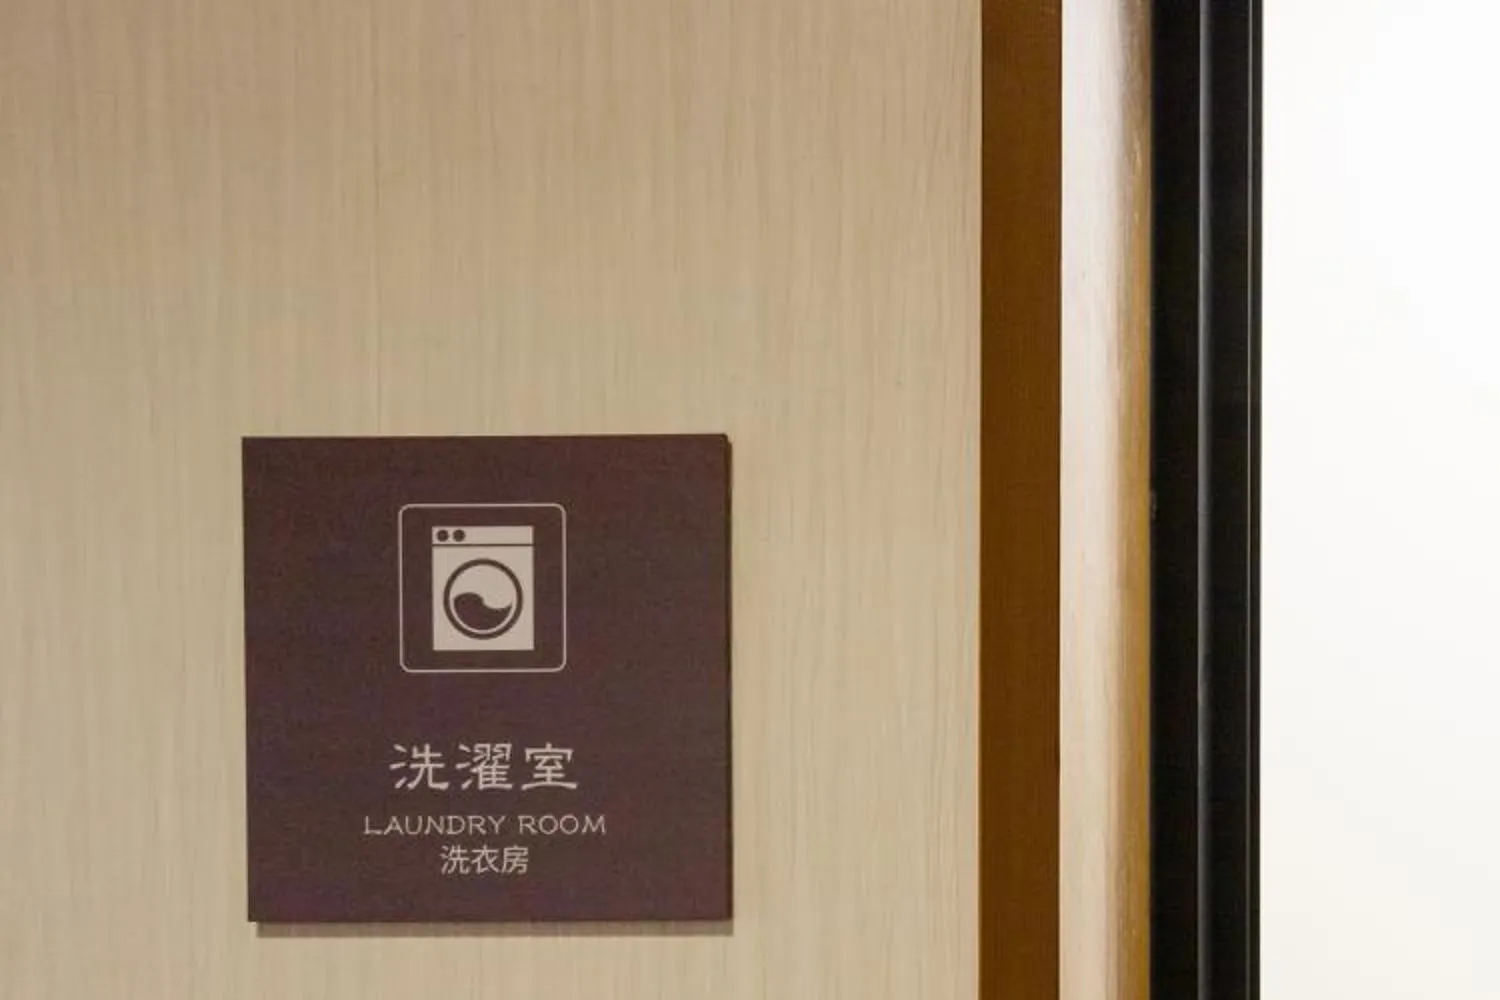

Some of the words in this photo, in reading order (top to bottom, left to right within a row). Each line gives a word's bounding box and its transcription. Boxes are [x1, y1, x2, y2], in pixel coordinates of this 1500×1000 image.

[389, 743, 578, 791] 洗濯室
[363, 815, 506, 836] LAUNDRY
[518, 815, 607, 836] ROOM
[440, 845, 529, 875] 洗衣房
